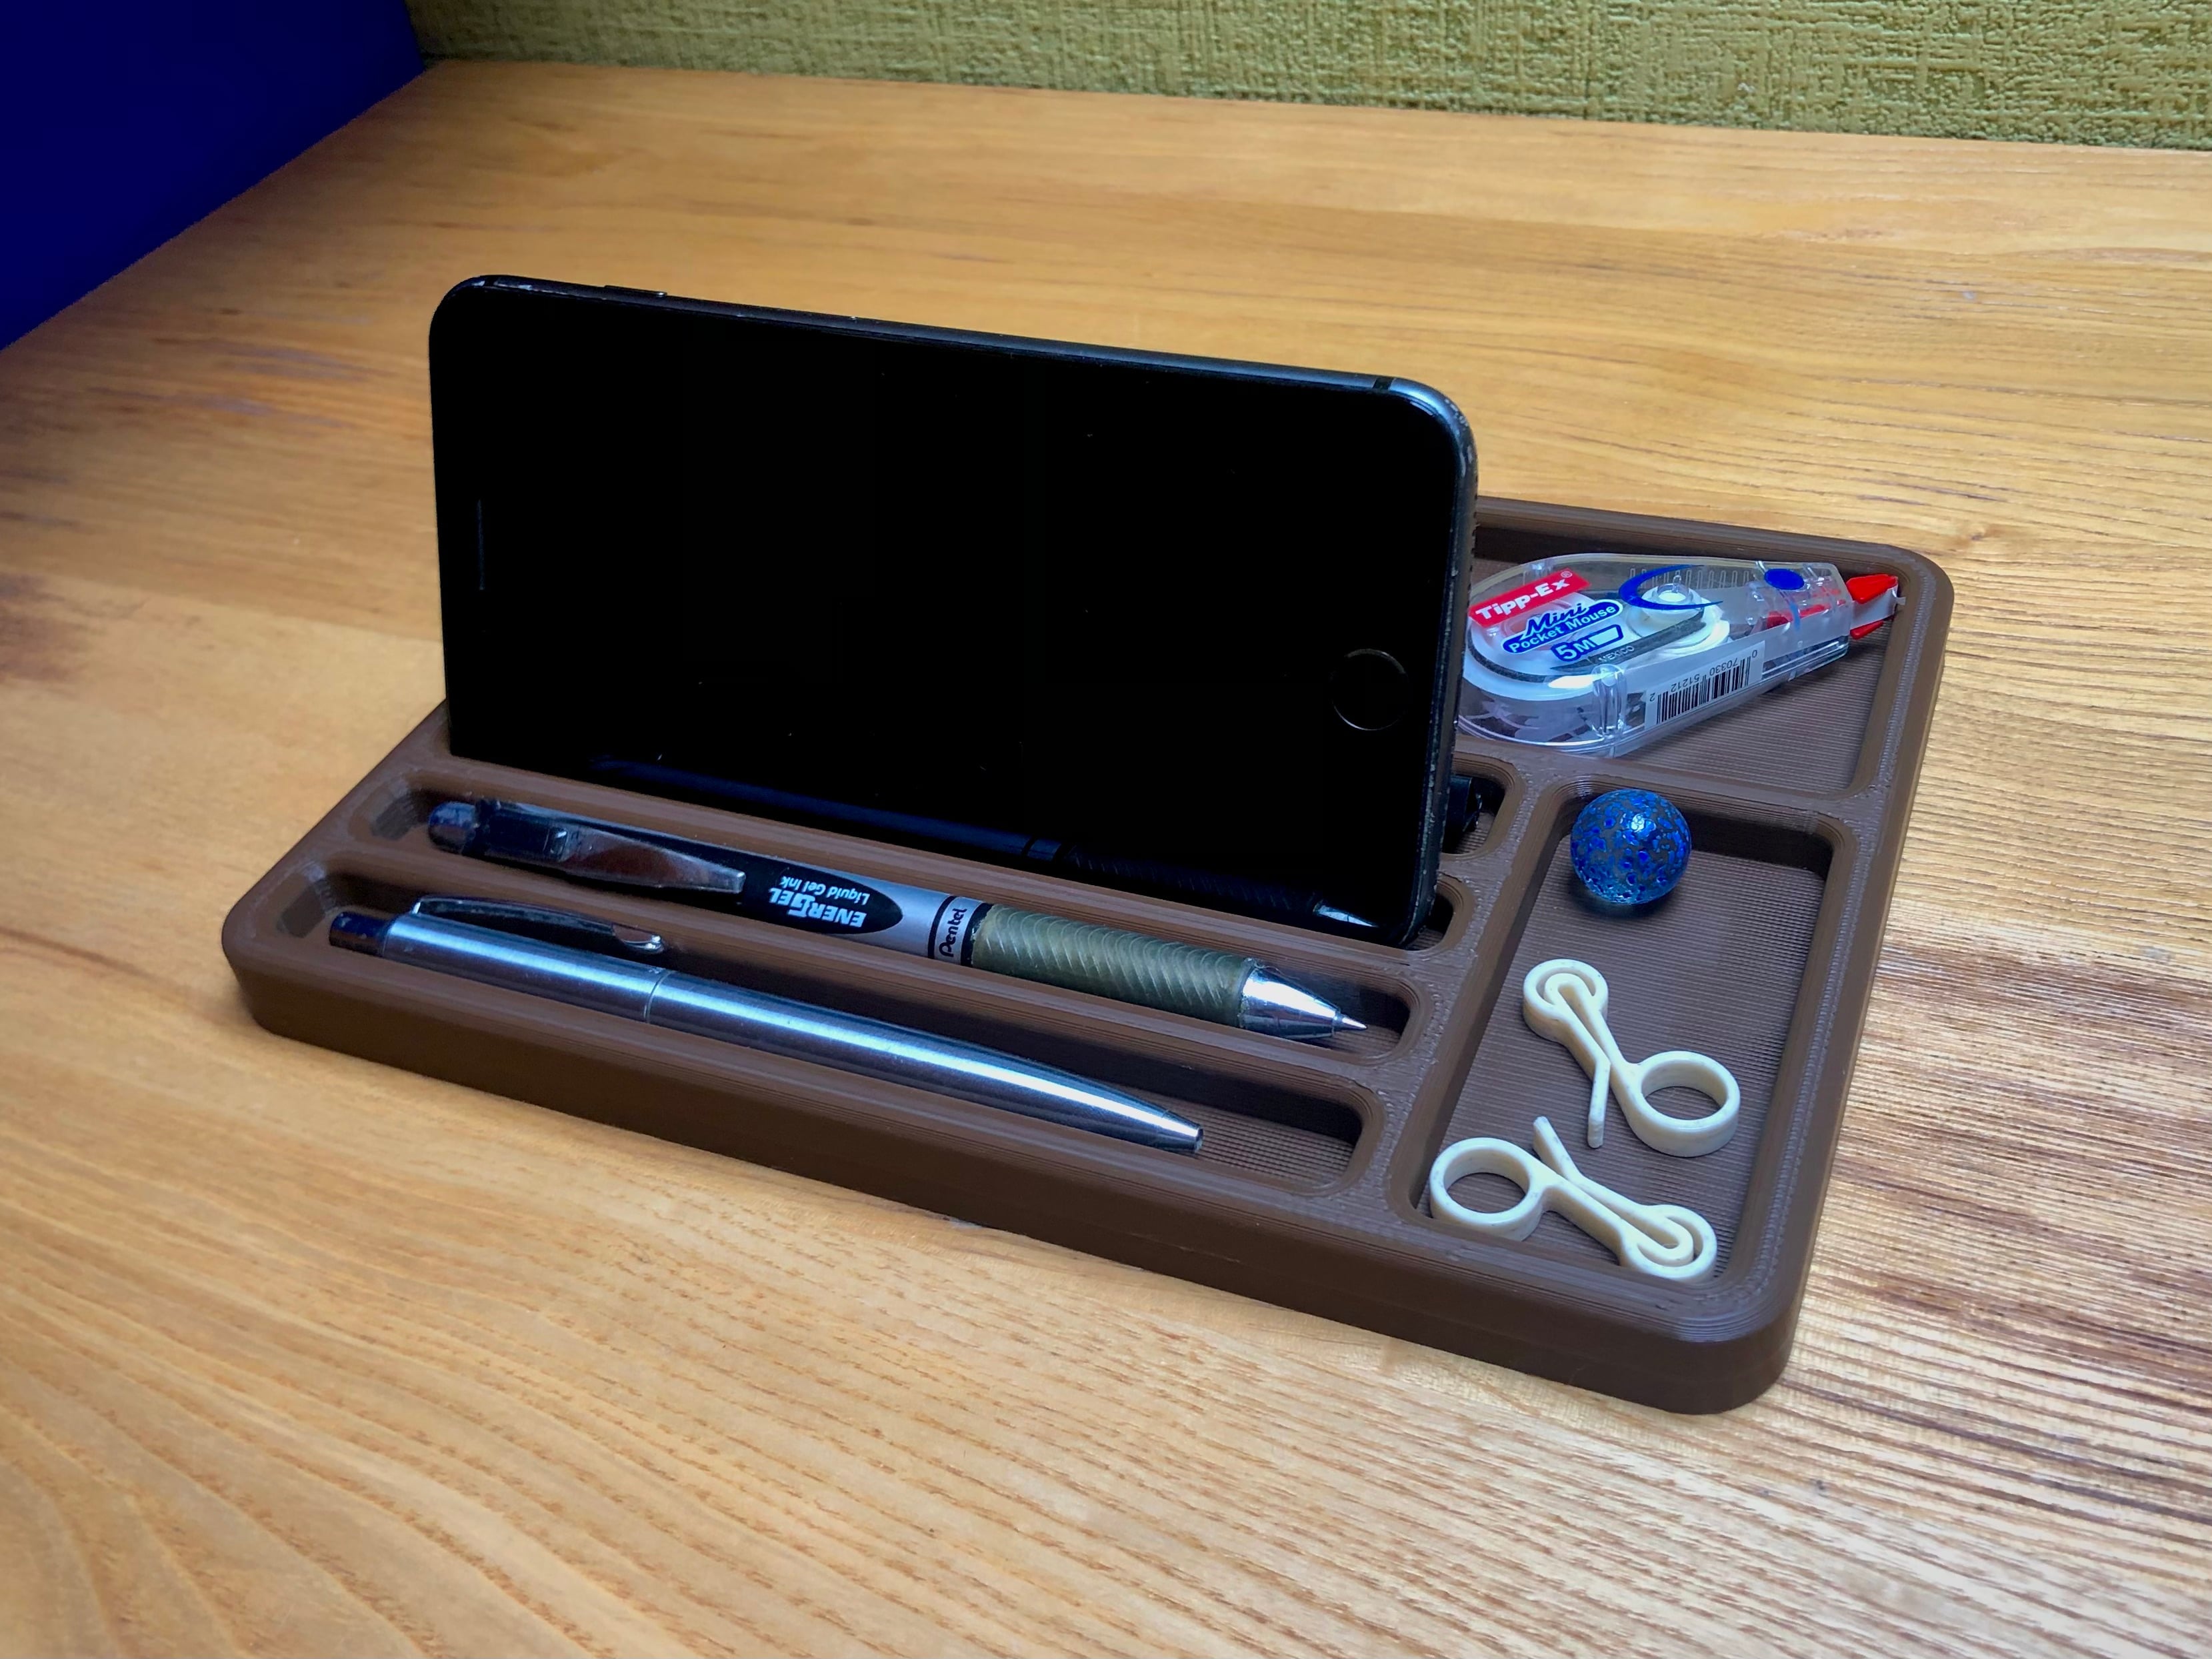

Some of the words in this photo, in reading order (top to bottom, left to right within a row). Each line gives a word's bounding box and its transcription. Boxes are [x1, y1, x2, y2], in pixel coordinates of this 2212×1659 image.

[1509, 626, 1564, 653] Pocket
[1565, 606, 1616, 631] Mouse
[1523, 603, 1587, 637] Mini
[1751, 649, 1759, 659] 0
[1709, 657, 1738, 676] 70330
[1671, 674, 1700, 693] 51212
[1649, 693, 1655, 702] 2
[779, 876, 802, 890] Ink
[801, 880, 826, 896] Gel
[826, 886, 870, 905] Liquid
[769, 887, 867, 928] ENERGEL
[939, 908, 967, 958] Pentel
